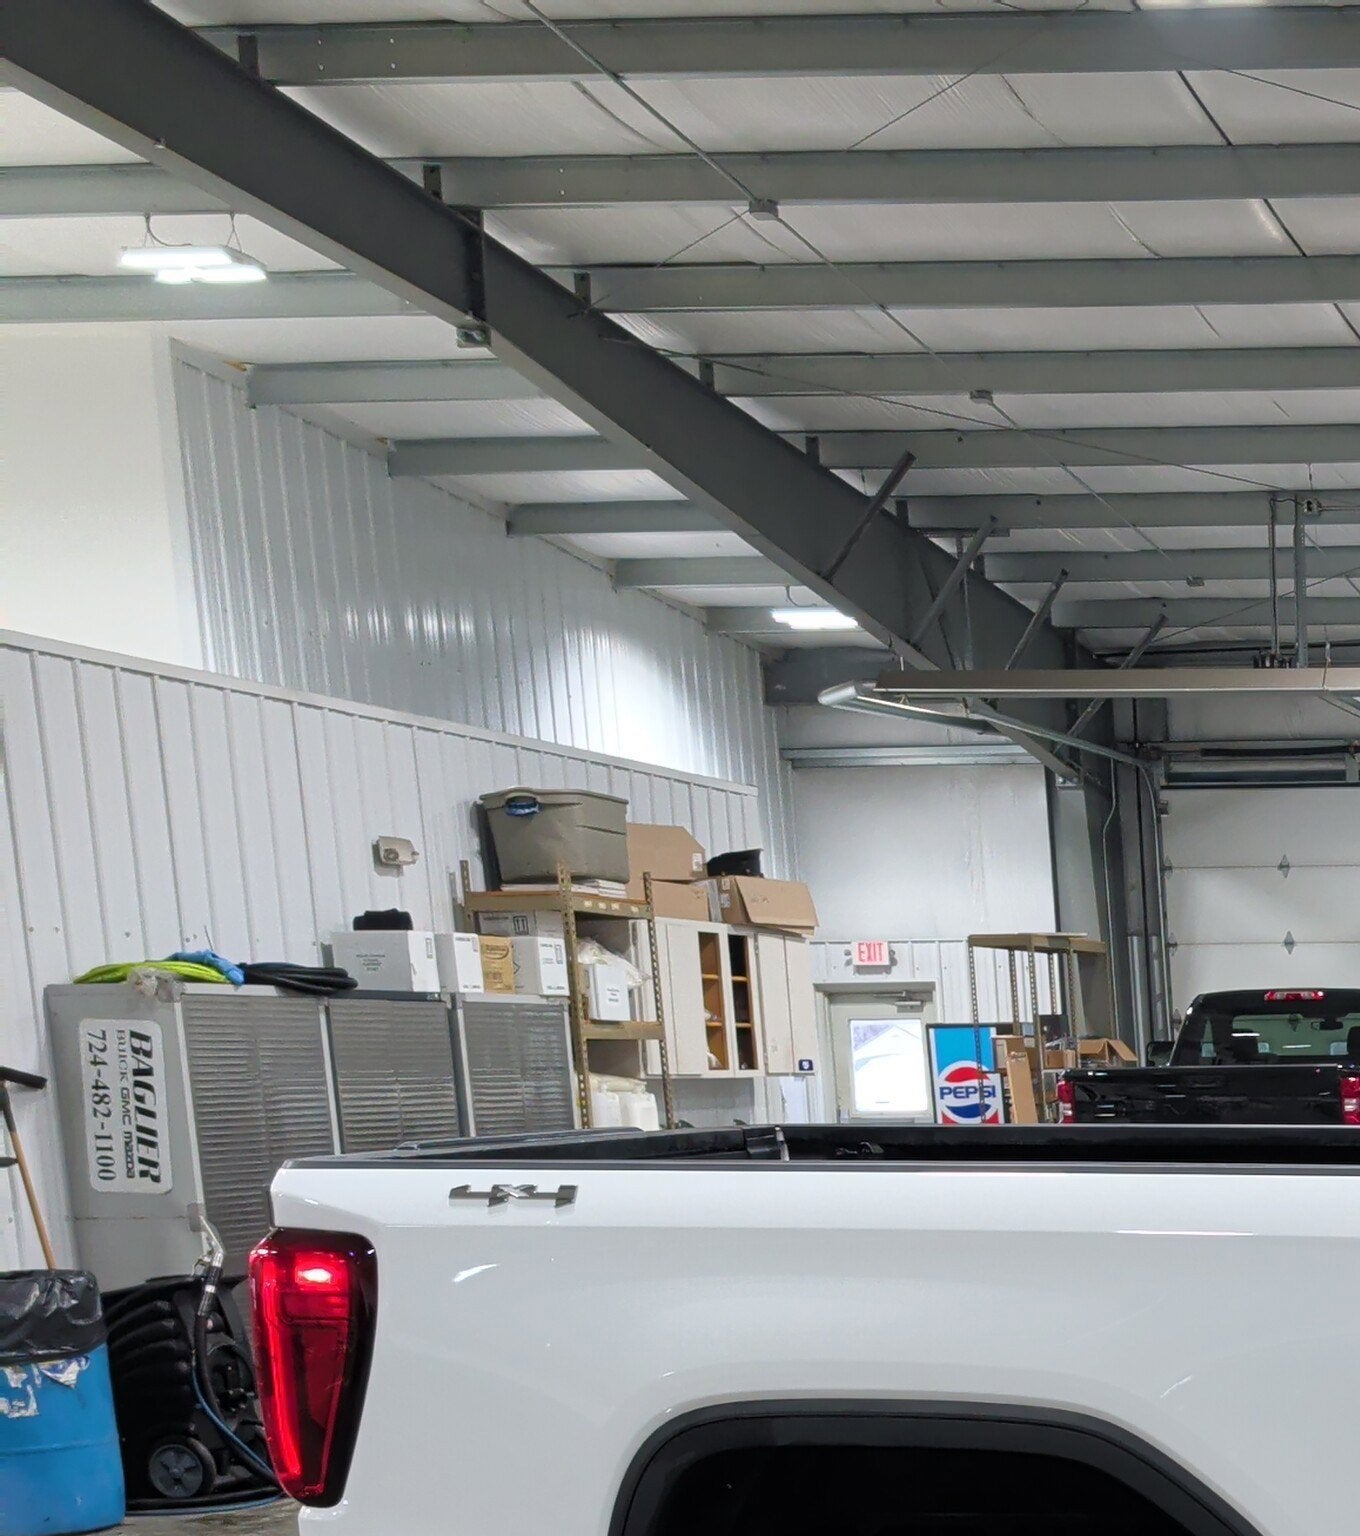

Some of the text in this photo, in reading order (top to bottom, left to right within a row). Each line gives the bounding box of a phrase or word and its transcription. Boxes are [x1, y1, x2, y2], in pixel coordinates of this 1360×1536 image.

[857, 942, 884, 963] EXIT
[87, 1028, 117, 1181] 724-482-1100
[116, 1029, 136, 1180] BUICK GMC mazda
[129, 1029, 161, 1184] BAGLIER
[939, 1085, 997, 1100] PEPSI
